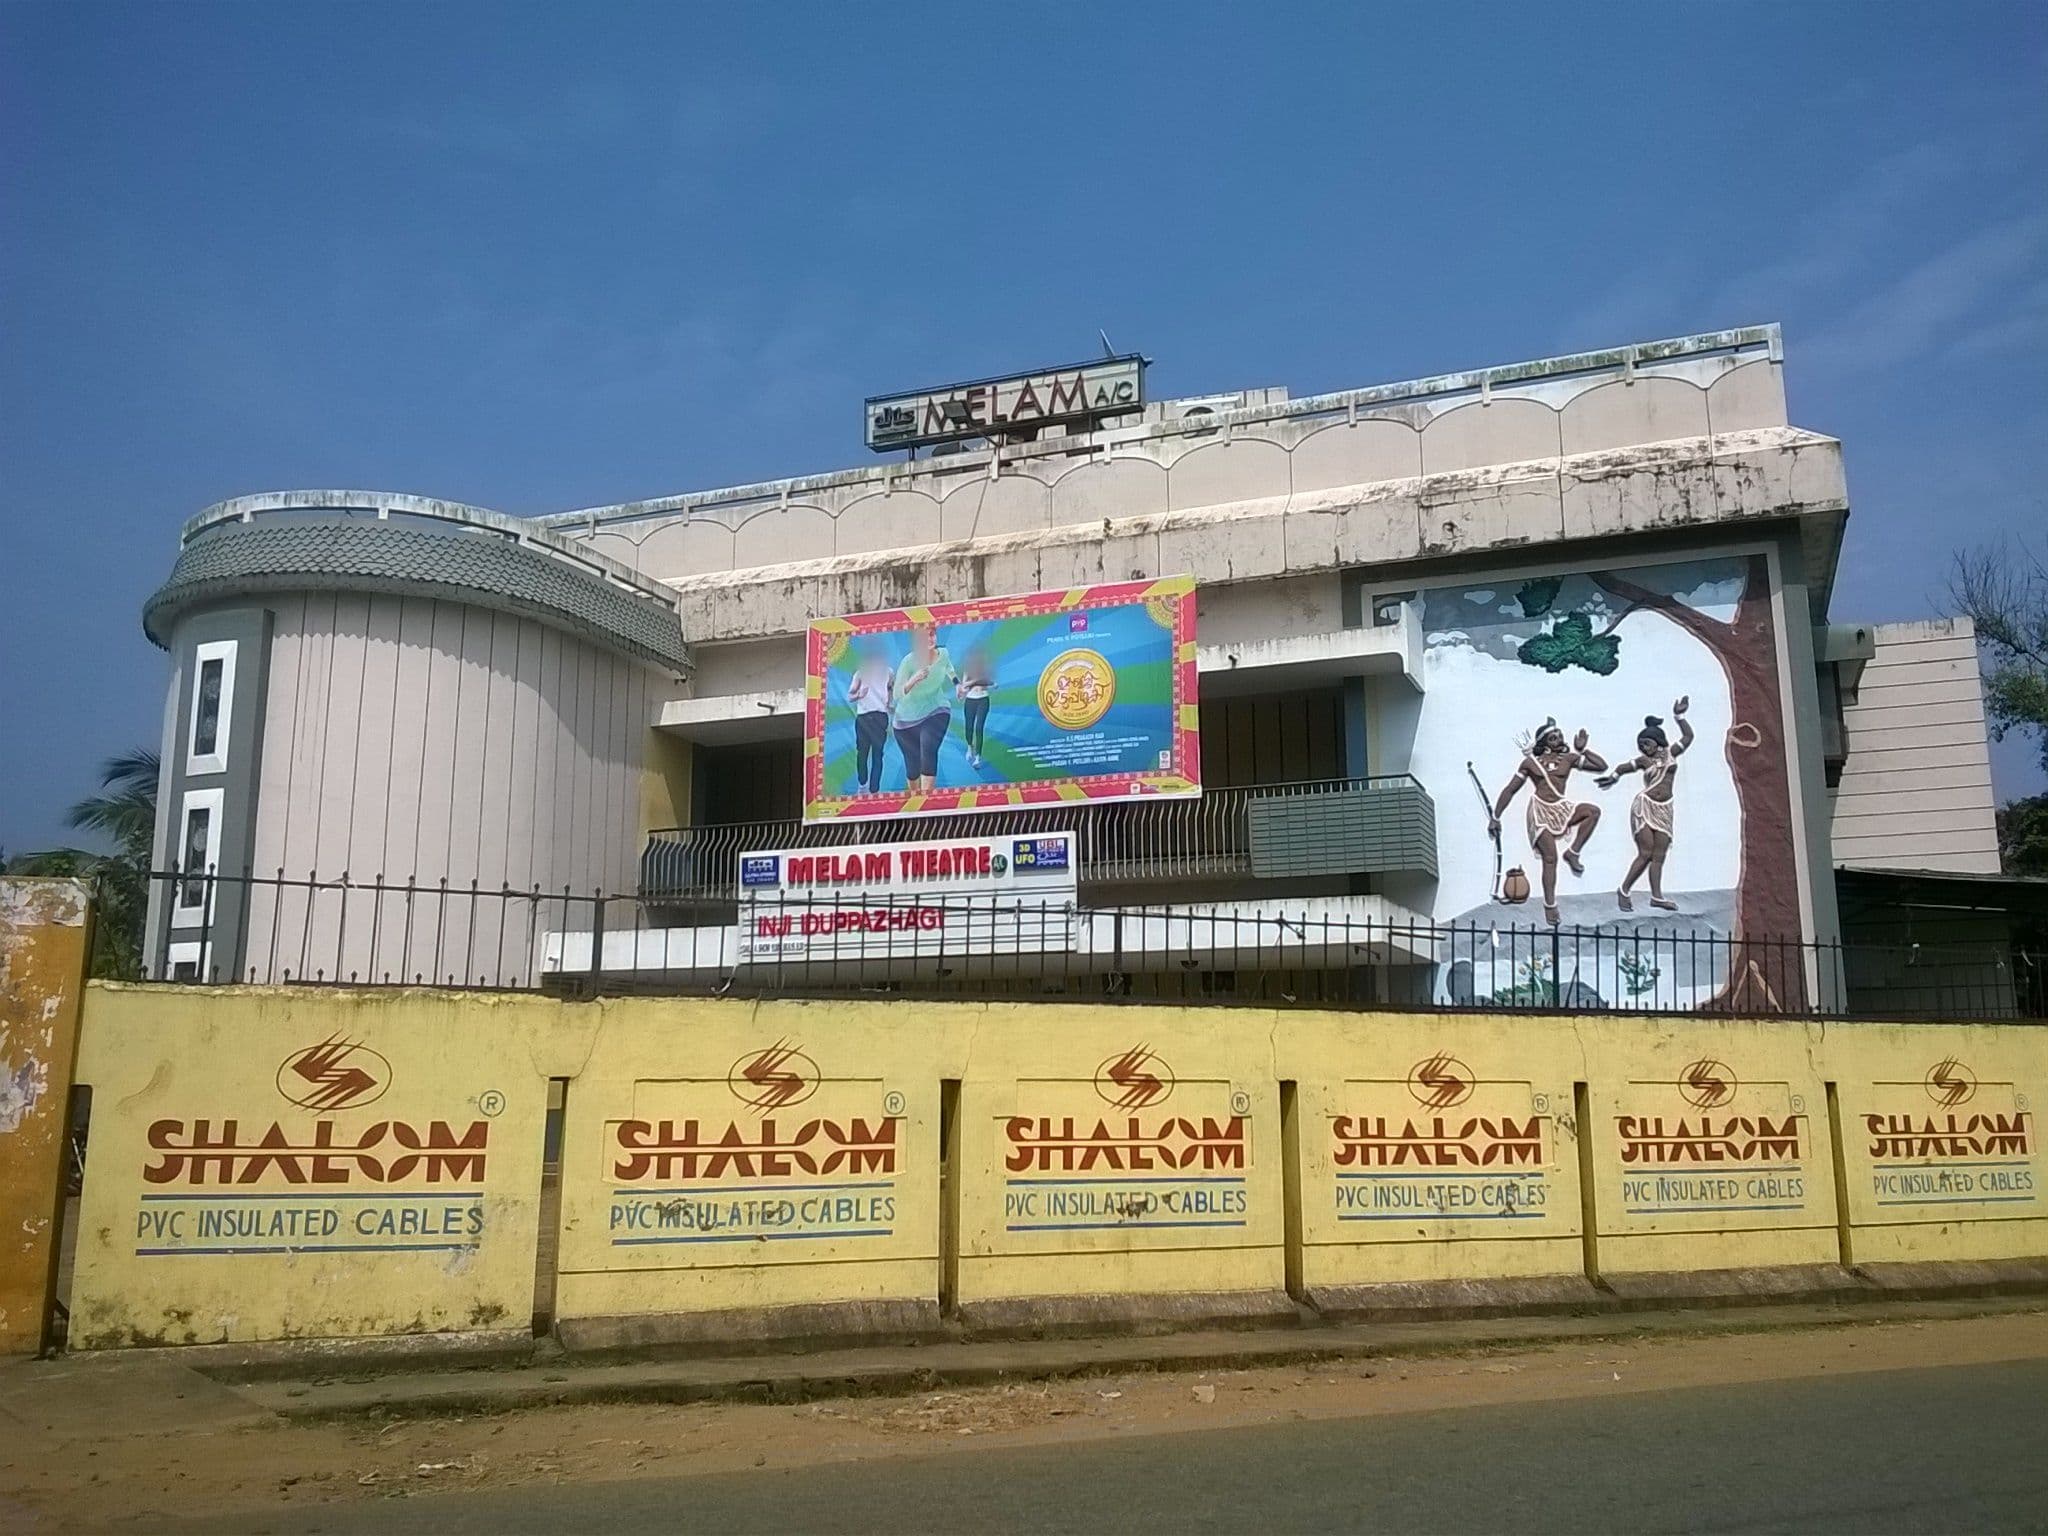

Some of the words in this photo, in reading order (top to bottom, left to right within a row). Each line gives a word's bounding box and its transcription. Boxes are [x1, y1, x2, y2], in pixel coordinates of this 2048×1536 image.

[923, 371, 1090, 434] MELAM
[1094, 381, 1133, 405] A/C
[787, 851, 892, 884] MELAM
[900, 846, 991, 877] THEATRE
[1015, 853, 1035, 865] UFO
[1018, 843, 1031, 853] 3D
[758, 914, 792, 938] INJI
[143, 1119, 489, 1184] SHALOM
[614, 1117, 897, 1180] SHALOM
[1005, 1117, 1244, 1172] SHALOM
[1333, 1116, 1542, 1166] SHALOM
[1618, 1116, 1800, 1163] SHALOM
[1866, 1113, 2028, 1158] SHALOM
[1336, 1185, 1368, 1208] PVC
[1481, 1184, 1545, 1206] CABLES
[1623, 1181, 1651, 1202] PVC
[1656, 1180, 1739, 1201] INSULATED
[1747, 1178, 1804, 1199] CABLES
[1873, 1175, 1897, 1194] PVC
[1901, 1173, 1974, 1194] INSULATED
[1979, 1171, 2033, 1191] CABLES
[610, 1203, 653, 1230] PVC
[801, 1196, 896, 1224] CABLES
[1005, 1193, 1038, 1217] PVC
[1046, 1191, 1158, 1217] INSULATED
[1167, 1190, 1247, 1214] CABLES
[137, 1209, 184, 1239] PVC
[197, 1207, 339, 1238] INSULATED
[355, 1206, 484, 1236] CABLES
